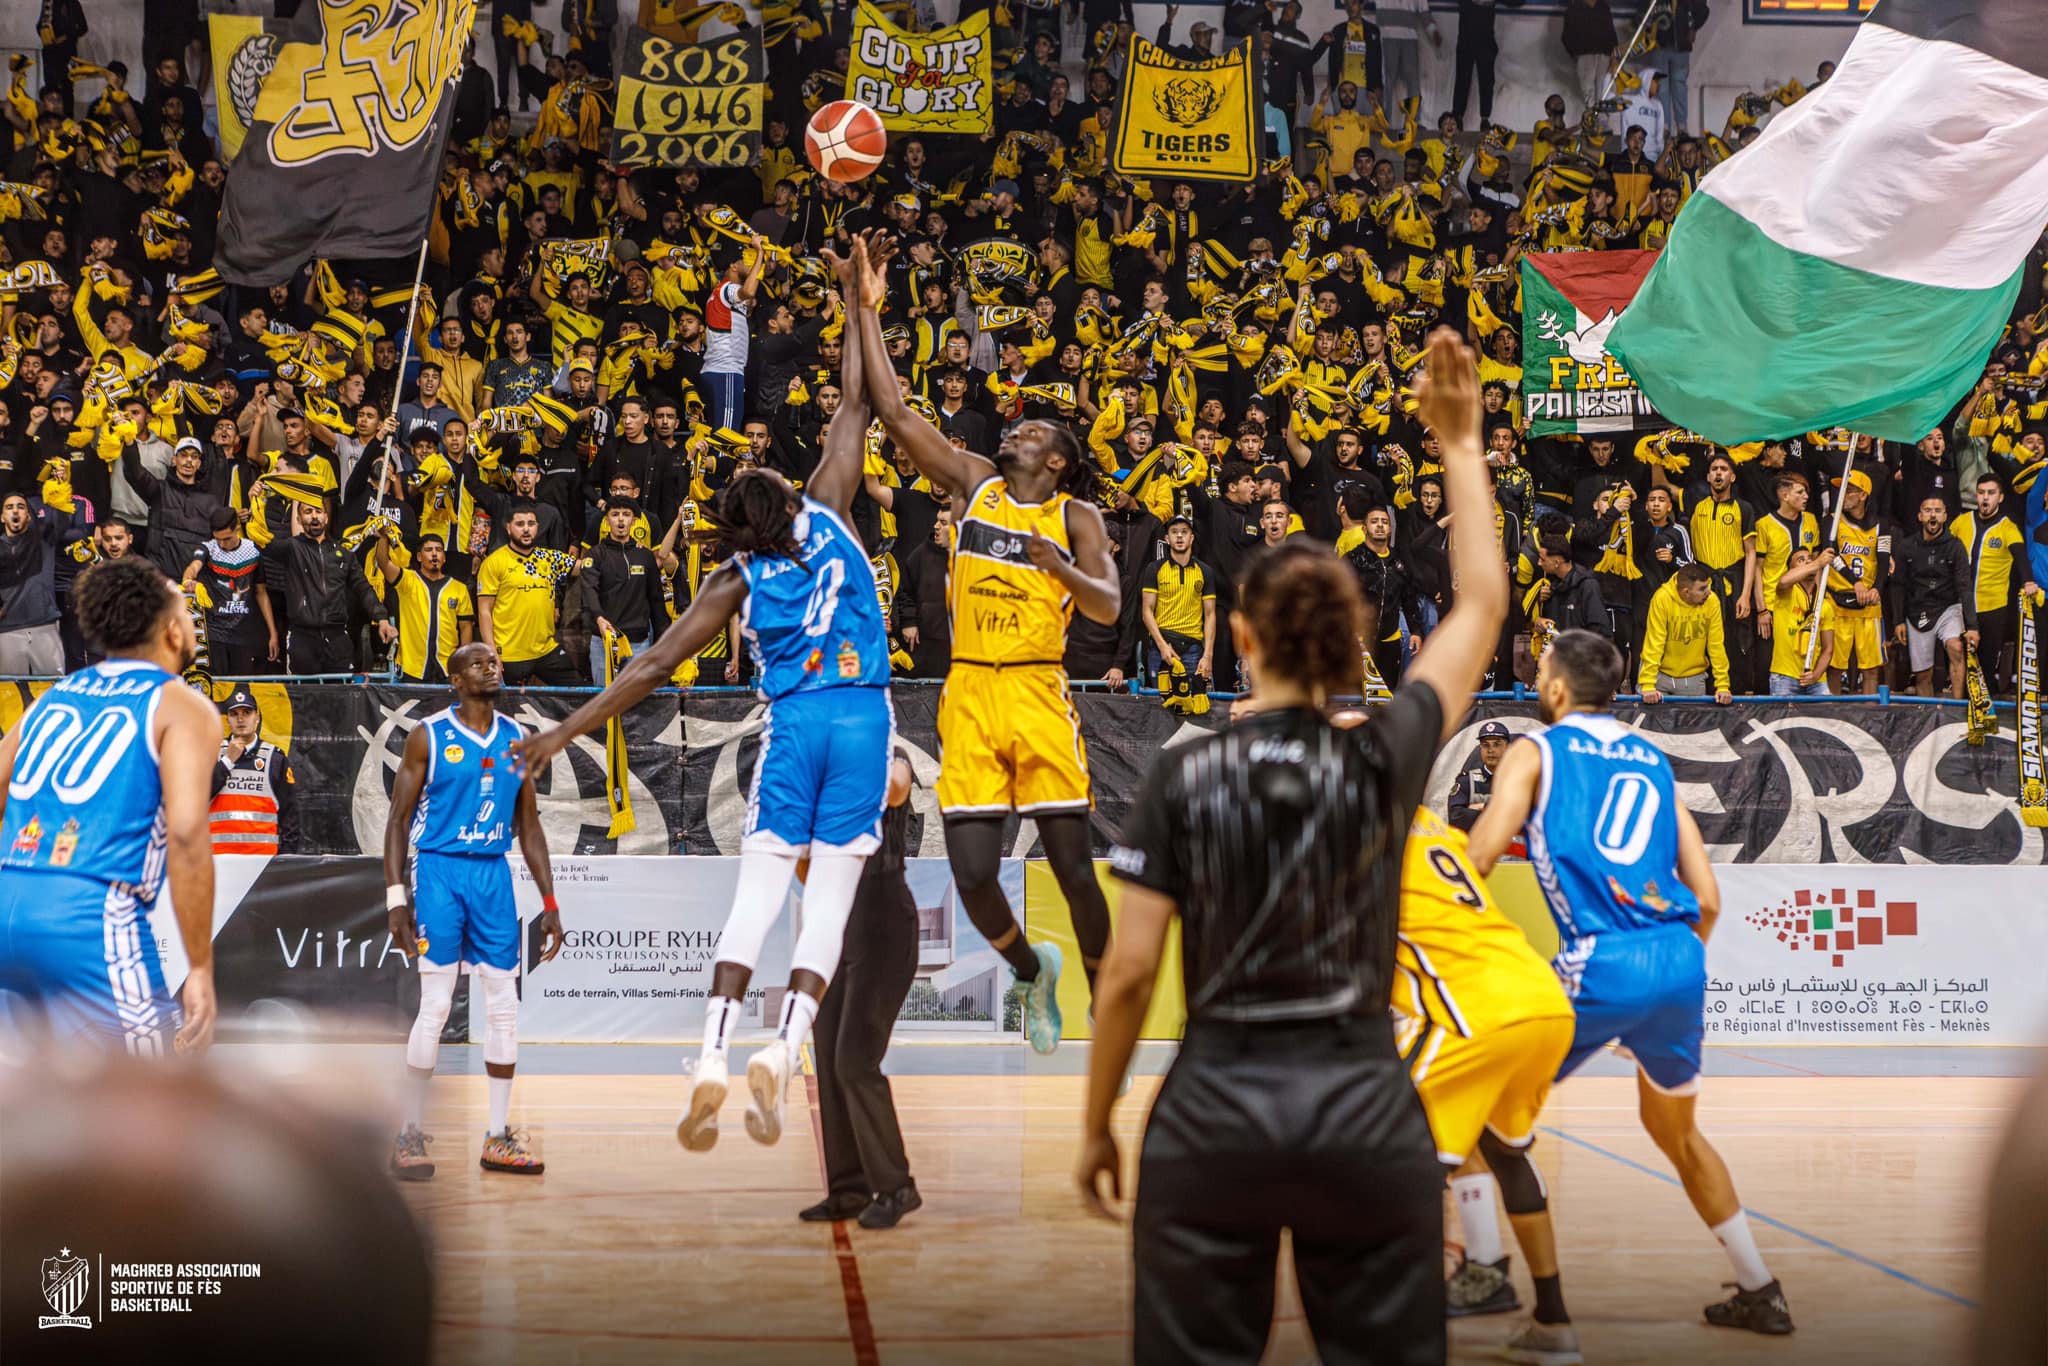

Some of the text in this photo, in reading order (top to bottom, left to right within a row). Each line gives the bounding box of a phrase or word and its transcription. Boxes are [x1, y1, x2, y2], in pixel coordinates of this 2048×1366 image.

[640, 37, 749, 86] 808
[860, 26, 982, 75] GO UP
[633, 84, 752, 132] 1946
[619, 130, 750, 167] 2006
[1141, 130, 1231, 153] TIGERS
[1549, 356, 1637, 390] FRE
[1851, 557, 1864, 577] 6
[802, 558, 845, 637] 0
[974, 608, 1020, 638] VitrA
[2021, 617, 2042, 778] SIAMO TIFOSI
[9, 703, 138, 805] 00
[226, 782, 264, 791] OLICE
[1593, 772, 1661, 866] 0
[1425, 845, 1485, 912] 9
[276, 927, 410, 968] VitrA
[562, 951, 679, 960] CONSTRUISONS
[563, 930, 661, 948] GROUPE
[544, 989, 565, 998] Lots
[568, 989, 580, 998] de
[584, 989, 619, 1000] terrain,
[622, 989, 648, 998] Villas
[651, 989, 705, 998] Semi-Finie
[1739, 978, 1776, 996] فاس
[1724, 1018, 1782, 1035] Régional
[1786, 1018, 1898, 1032] d'Investissement
[1903, 1018, 1925, 1032] Fès
[1941, 1018, 1990, 1032] Meknès
